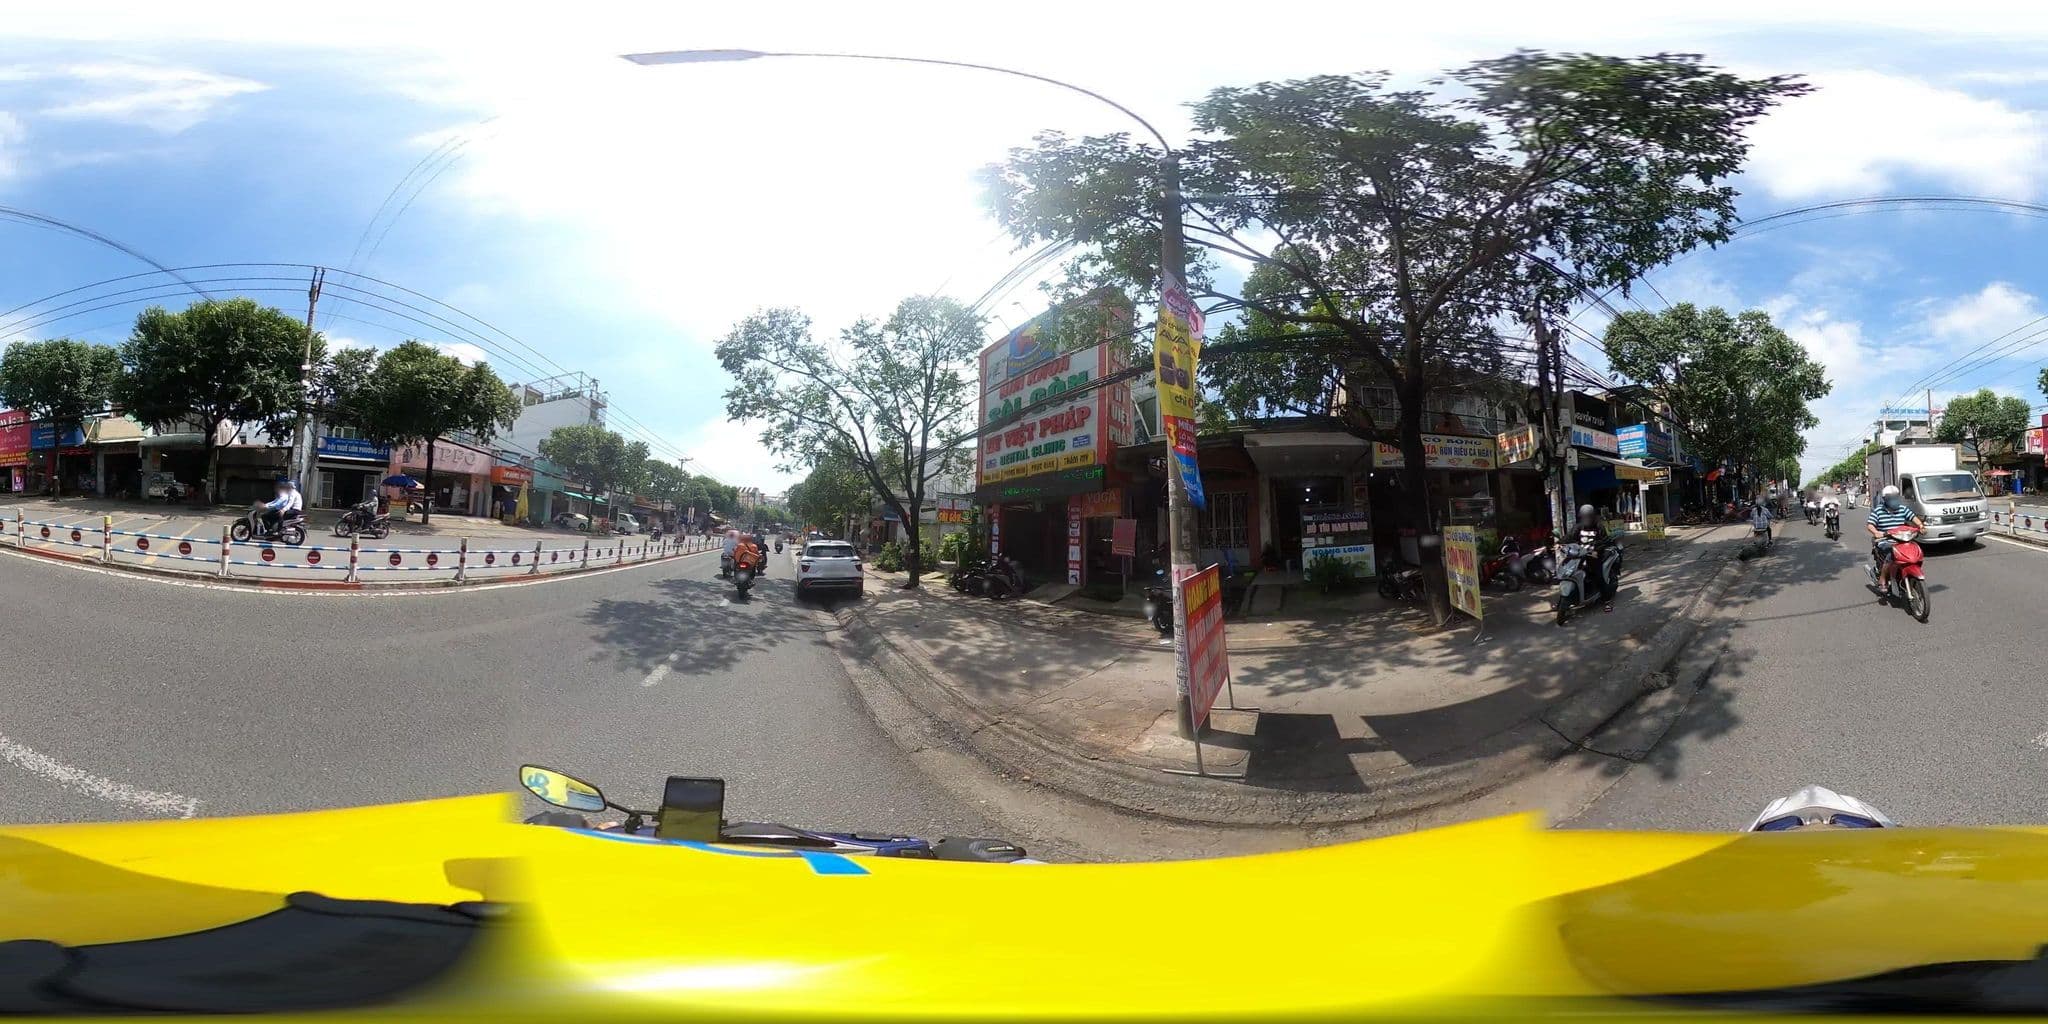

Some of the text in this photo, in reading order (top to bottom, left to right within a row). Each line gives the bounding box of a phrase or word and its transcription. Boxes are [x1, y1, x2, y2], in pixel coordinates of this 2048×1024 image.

[1030, 369, 1088, 414] GÒN
[1004, 422, 1036, 448] VIỆT
[1039, 405, 1091, 438] PHÁP
[1031, 439, 1066, 457] CLINIC
[1087, 491, 1117, 504] YOGA
[1942, 504, 1979, 515] SUZUKI
